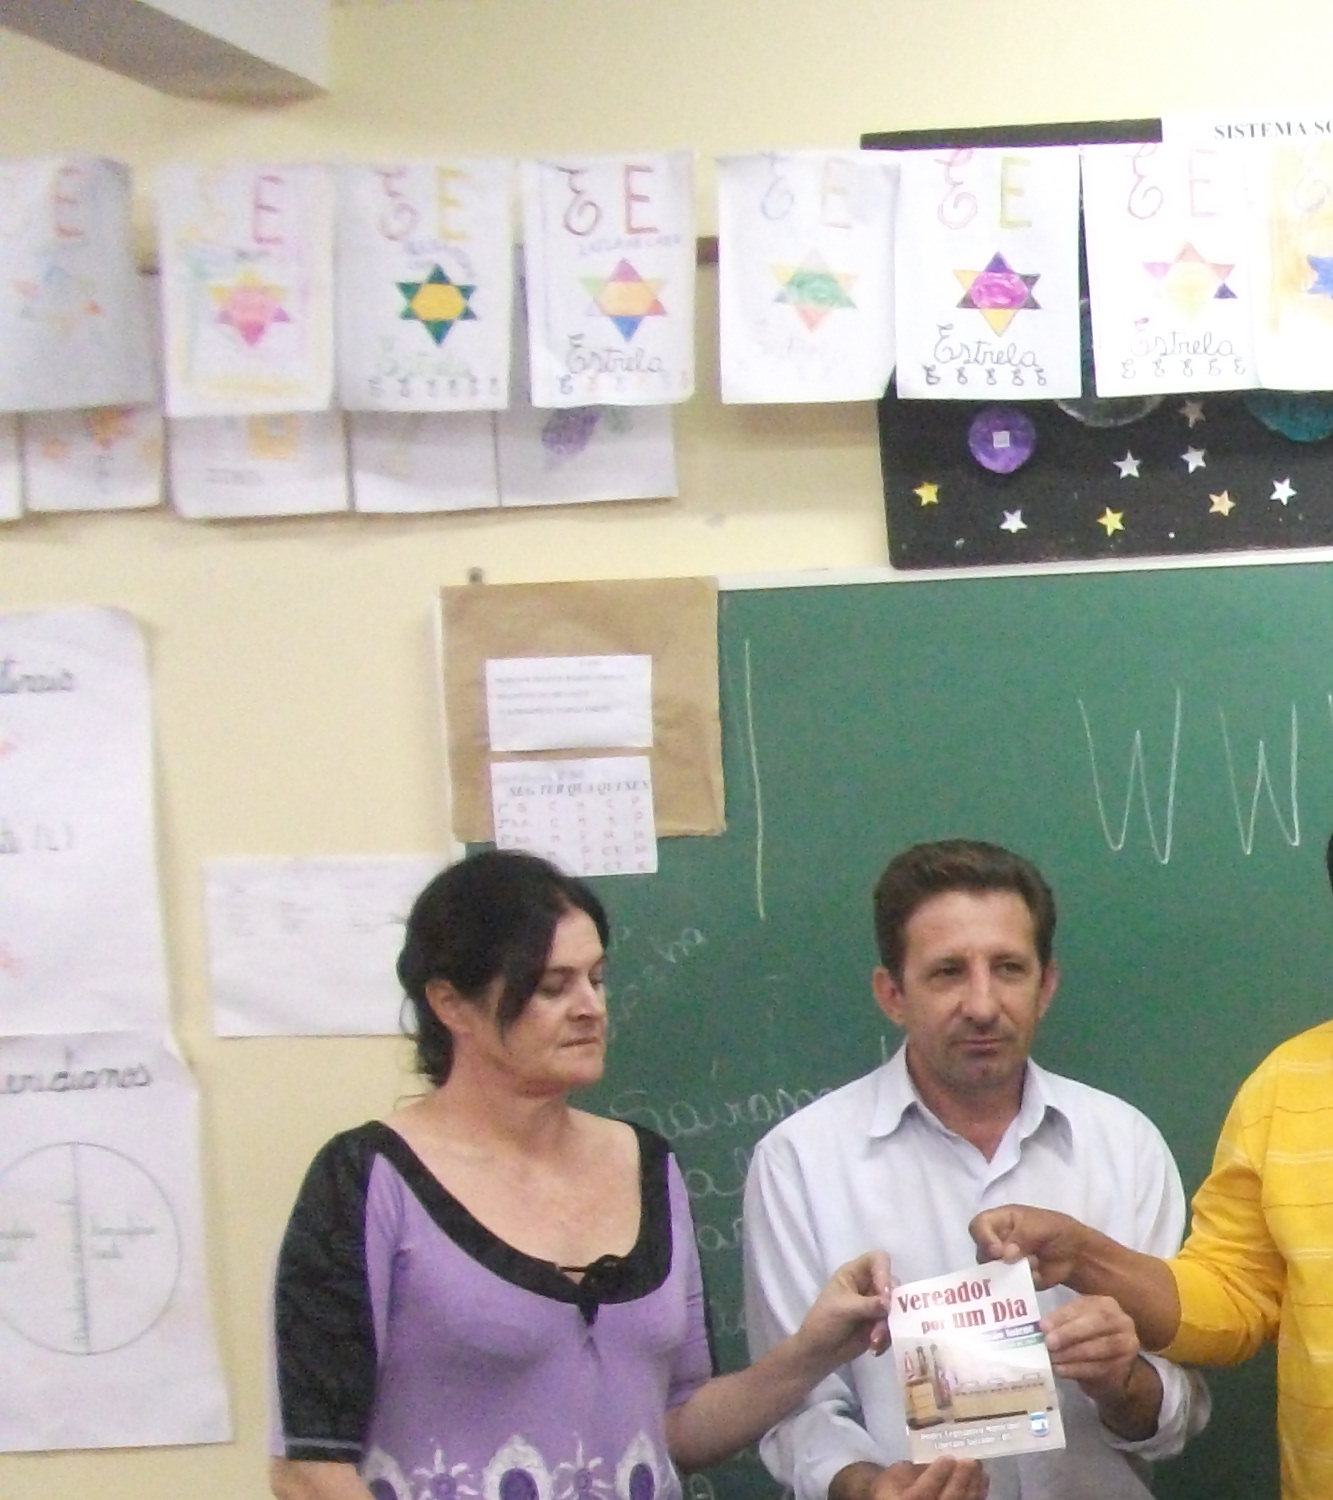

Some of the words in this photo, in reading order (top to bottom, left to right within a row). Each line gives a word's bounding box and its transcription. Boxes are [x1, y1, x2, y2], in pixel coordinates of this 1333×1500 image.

[1213, 120, 1308, 141] SISTEMA
[567, 333, 665, 374] Estrela
[933, 323, 1041, 369] Estrela
[896, 1276, 992, 1315] Vereador
[921, 1319, 946, 1335] por
[952, 1307, 987, 1330] um
